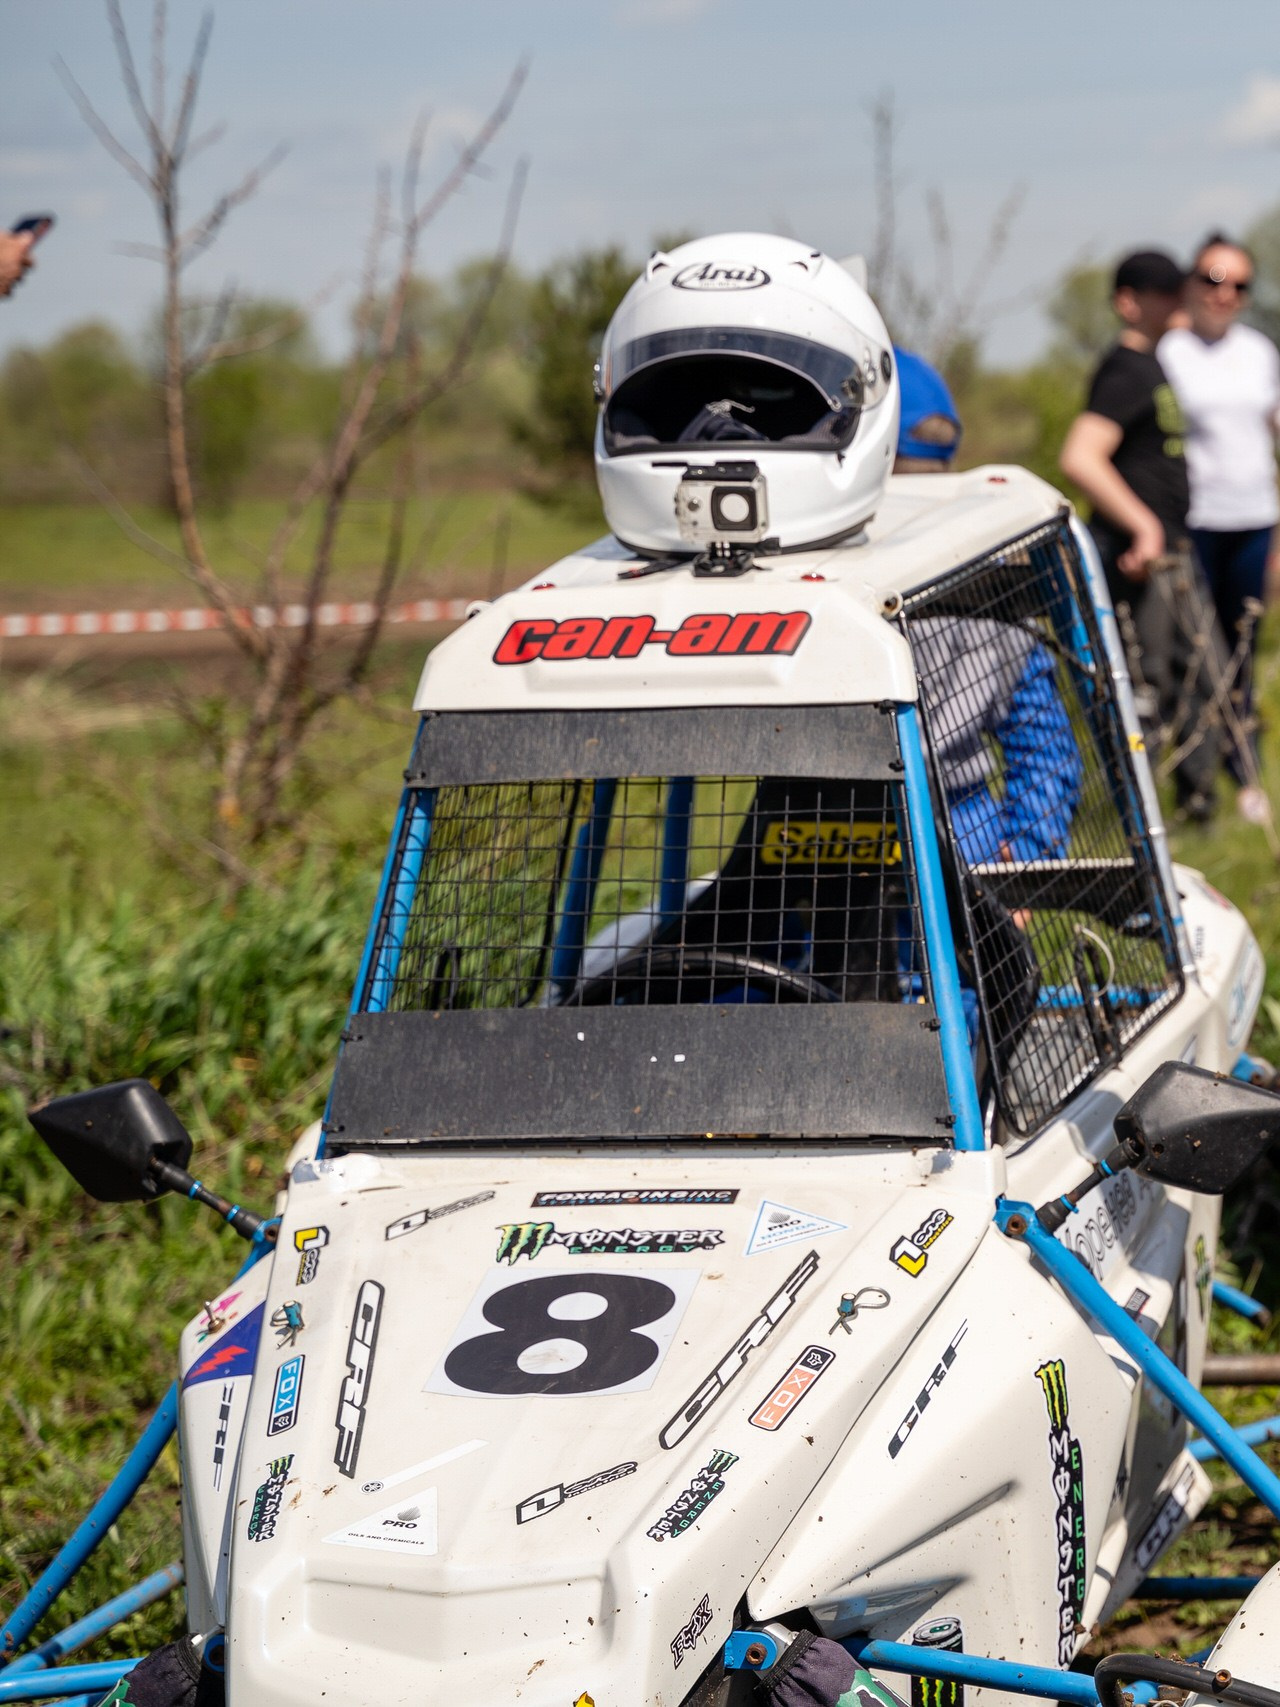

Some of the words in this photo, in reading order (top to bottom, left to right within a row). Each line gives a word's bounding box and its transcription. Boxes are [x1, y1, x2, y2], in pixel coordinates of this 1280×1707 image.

[677, 262, 759, 285] Arai
[492, 611, 812, 665] can-am
[549, 1229, 724, 1247] MONSTER
[569, 1245, 696, 1254] ENERGY
[767, 1219, 801, 1232] PRO
[444, 1273, 677, 1395] 8
[658, 1249, 821, 1450] CRF
[277, 1363, 298, 1410] FOX
[334, 1279, 386, 1480] CRF
[760, 1373, 809, 1425] FOX
[249, 1486, 265, 1538] ENERGY
[258, 1473, 286, 1540] MONSTER
[382, 1519, 418, 1529] PRO
[648, 1469, 720, 1540] MONSTER
[673, 1481, 723, 1537] ENERGY
[383, 1536, 425, 1546] CHEMICALS
[1050, 1429, 1076, 1663] MONSTER
[1071, 1447, 1084, 1625] ENERG
